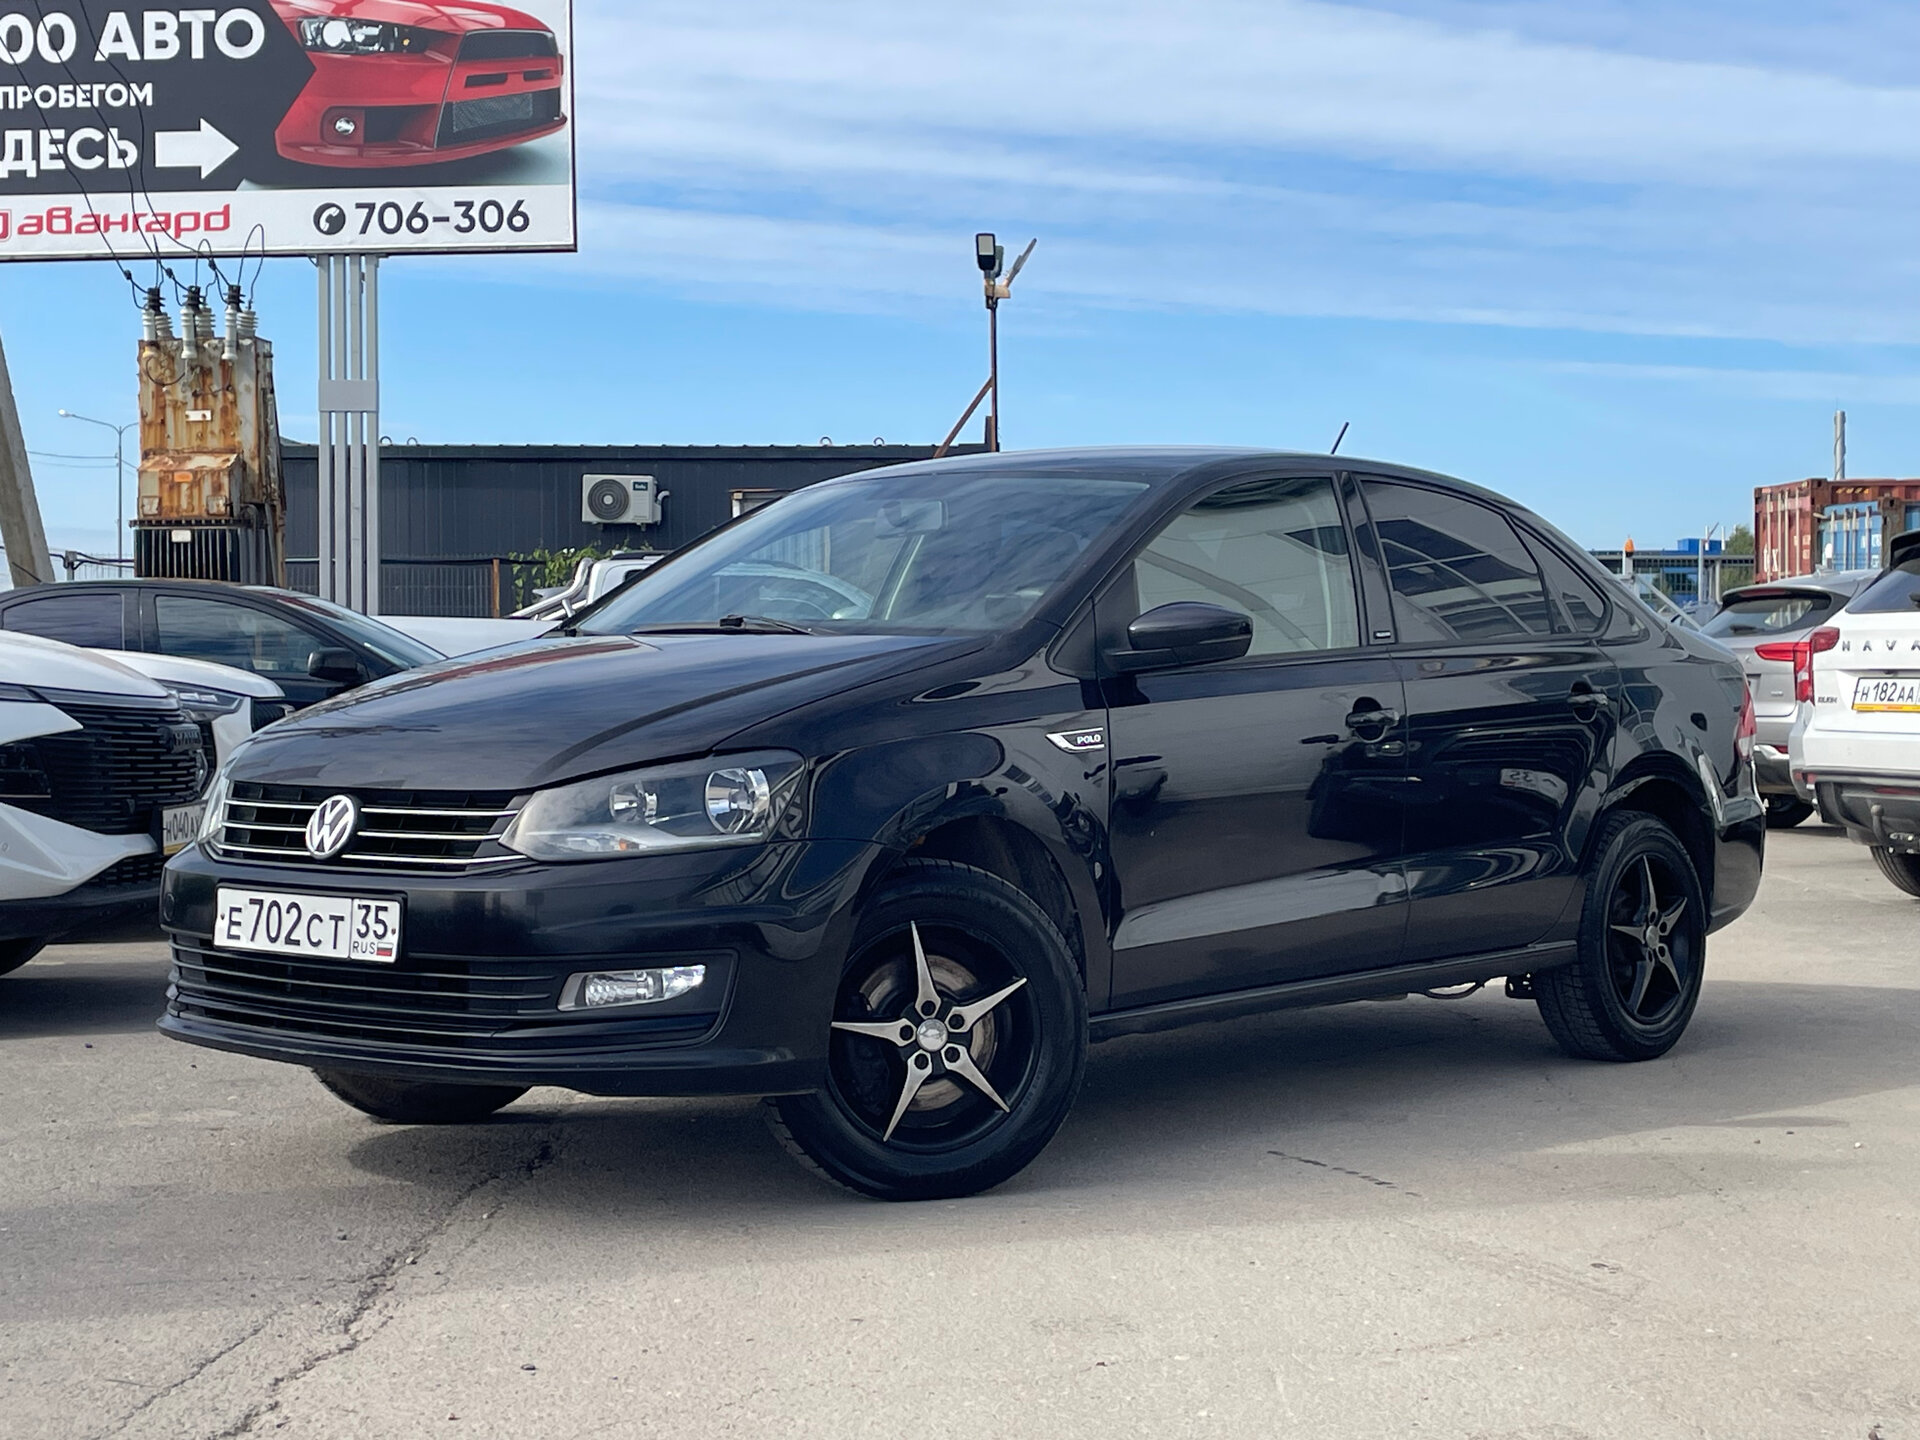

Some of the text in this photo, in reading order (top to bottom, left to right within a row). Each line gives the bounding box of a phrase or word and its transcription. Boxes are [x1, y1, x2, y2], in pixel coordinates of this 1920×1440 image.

[94, 8, 265, 61] АВТО
[0, 82, 153, 109] ПРОБЕГОМ
[0, 127, 138, 178] ДЕСЬ
[355, 199, 530, 235] 706-306
[1077, 734, 1101, 744] POLO
[226, 899, 389, 950] Е702СТ 35
[352, 941, 376, 956] RUS
